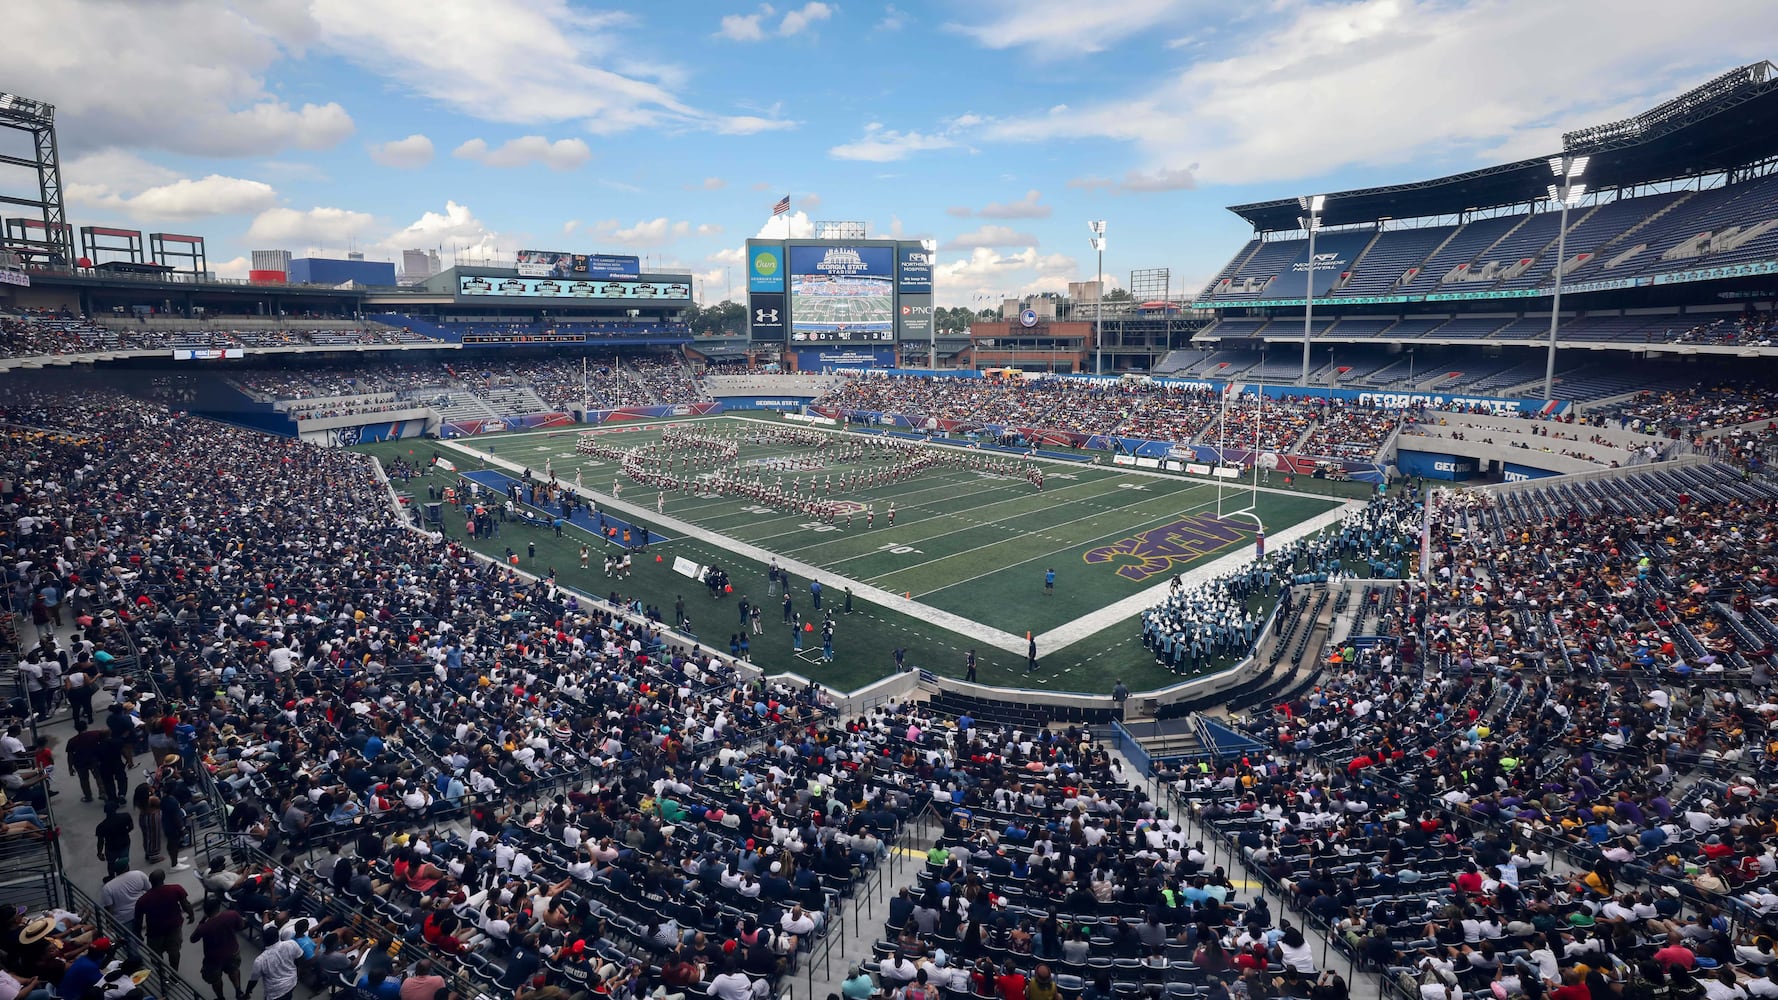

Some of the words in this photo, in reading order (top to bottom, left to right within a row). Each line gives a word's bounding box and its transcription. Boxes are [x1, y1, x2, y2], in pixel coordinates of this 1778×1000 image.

[912, 306, 931, 314] PNC
[1359, 393, 1444, 408] GEORGIA
[877, 542, 914, 554] 10
